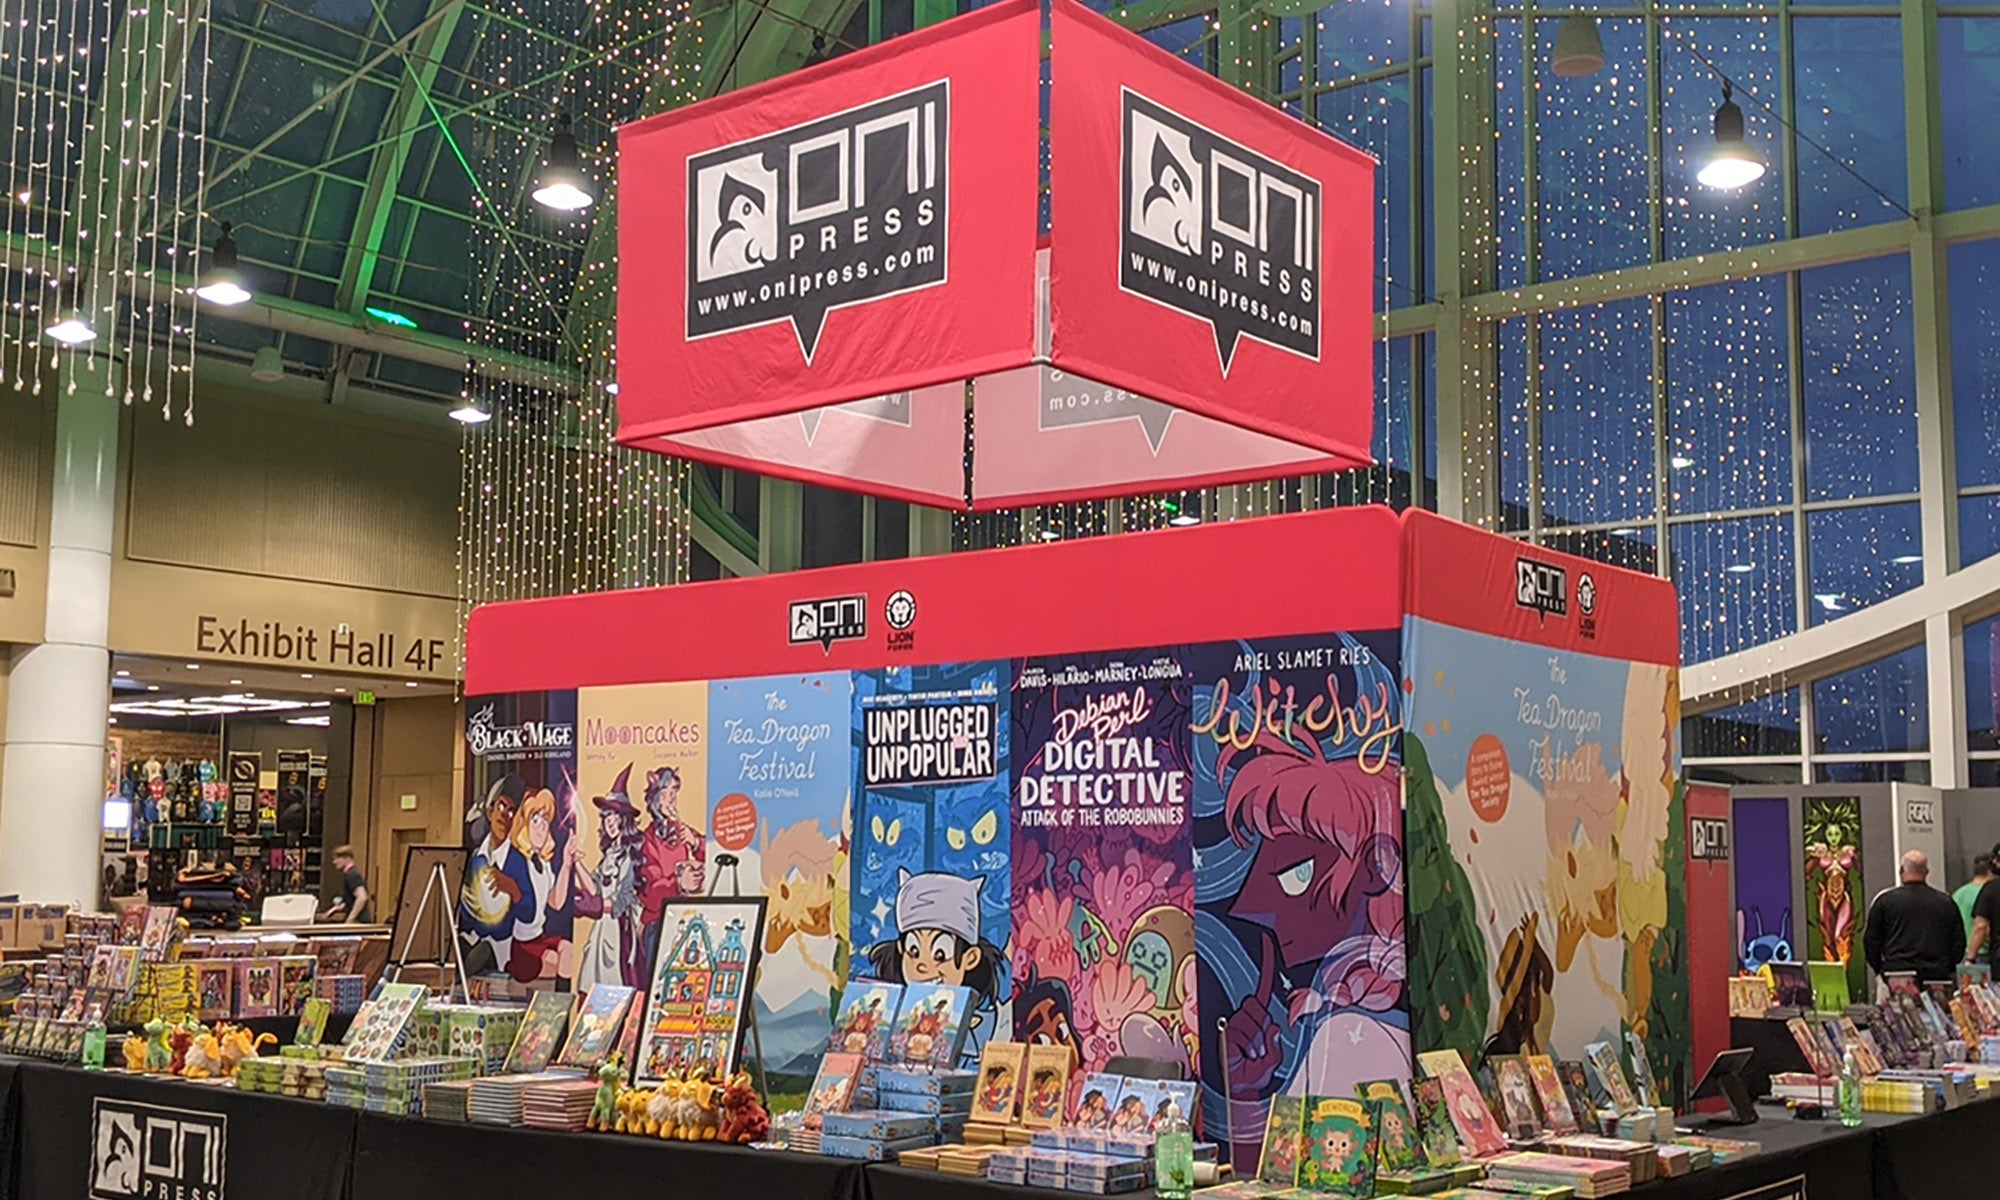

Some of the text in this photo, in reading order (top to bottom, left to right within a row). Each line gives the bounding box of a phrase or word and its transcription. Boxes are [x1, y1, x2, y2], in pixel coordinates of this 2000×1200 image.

[789, 199, 935, 260] PRESS
[697, 244, 935, 316] www.onipress.com
[1211, 240, 1313, 302] PRESS
[1131, 252, 1313, 336] www.onipress.com
[196, 616, 445, 672] Exhibit Hall 4F
[820, 625, 863, 637] PRESS
[887, 632, 914, 645] LION
[1020, 674, 1047, 688] DAVIS
[1053, 671, 1090, 686] HILARIO
[1095, 666, 1138, 683] MARNEY
[1143, 663, 1183, 680] LONGUA
[1234, 646, 1371, 672] ARIEL SLAMET RIES
[1547, 655, 1568, 684] The
[764, 690, 788, 711] The
[1053, 691, 1130, 745] Debian
[1091, 686, 1150, 744] Perl
[1514, 687, 1602, 746] Tea Dragon
[585, 717, 700, 747] Mooncakes
[724, 717, 831, 753] Tea Dragon
[867, 704, 990, 745] UNPLUGGED
[737, 748, 816, 782] Festival
[866, 739, 993, 784] UNPOPULAR
[1044, 736, 1160, 772] DIGITAL
[1528, 734, 1592, 783] Festival
[1020, 771, 1185, 808] DETECTIVE
[1020, 806, 1185, 827] ATTACK OF THE ROBOBUNNIES
